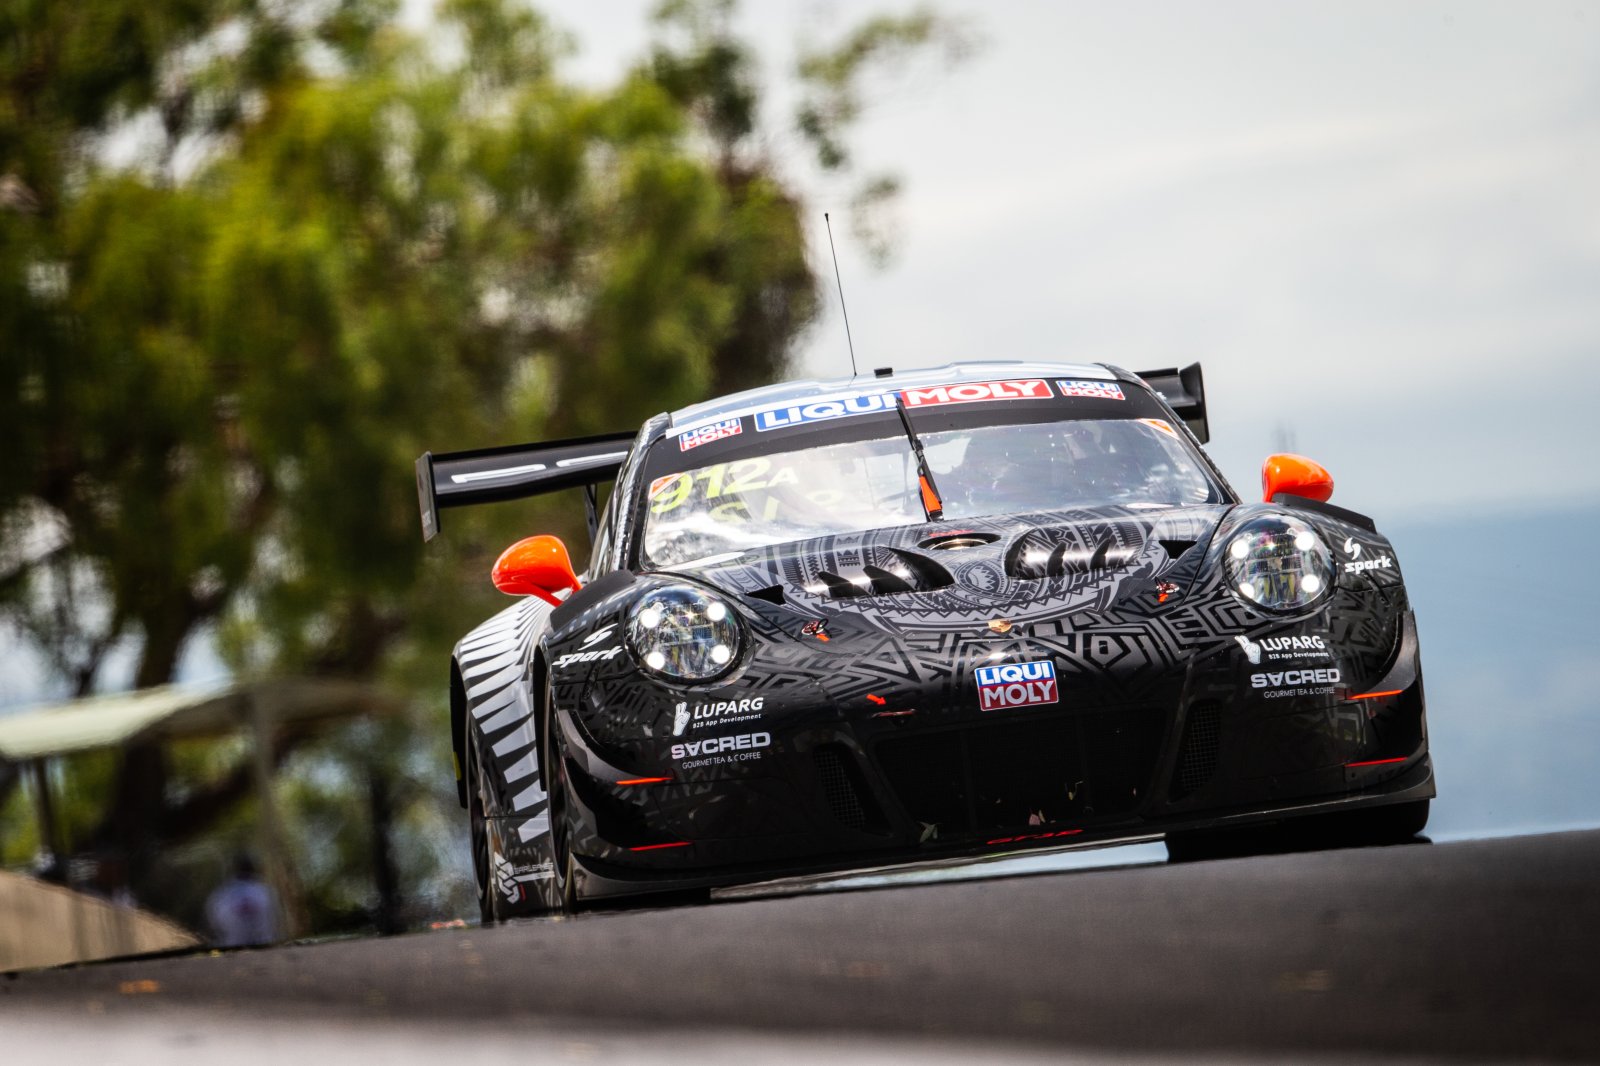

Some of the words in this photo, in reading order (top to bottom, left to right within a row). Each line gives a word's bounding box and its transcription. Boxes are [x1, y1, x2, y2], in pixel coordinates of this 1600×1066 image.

[1060, 380, 1119, 391] LIQUI
[1065, 387, 1121, 399] MOLY
[763, 392, 897, 428] LIQUI
[907, 381, 1042, 405] MOLY
[683, 419, 739, 441] LIQUI
[684, 426, 738, 450] MOLY
[1344, 555, 1392, 575] spark
[1260, 635, 1325, 651] LUPARG
[552, 645, 623, 668] spark
[979, 662, 1052, 685] LIQUI
[1250, 668, 1341, 688] SACRED
[983, 680, 1054, 708] MOLY
[1264, 689, 1296, 699] GOURMET
[1297, 688, 1307, 696] TEA
[694, 697, 764, 720] LUPARG
[692, 721, 705, 729] B2B
[719, 713, 762, 724] Development
[671, 732, 771, 759] SACRED
[682, 758, 712, 769] GOURMET
[713, 756, 726, 764] TEA
